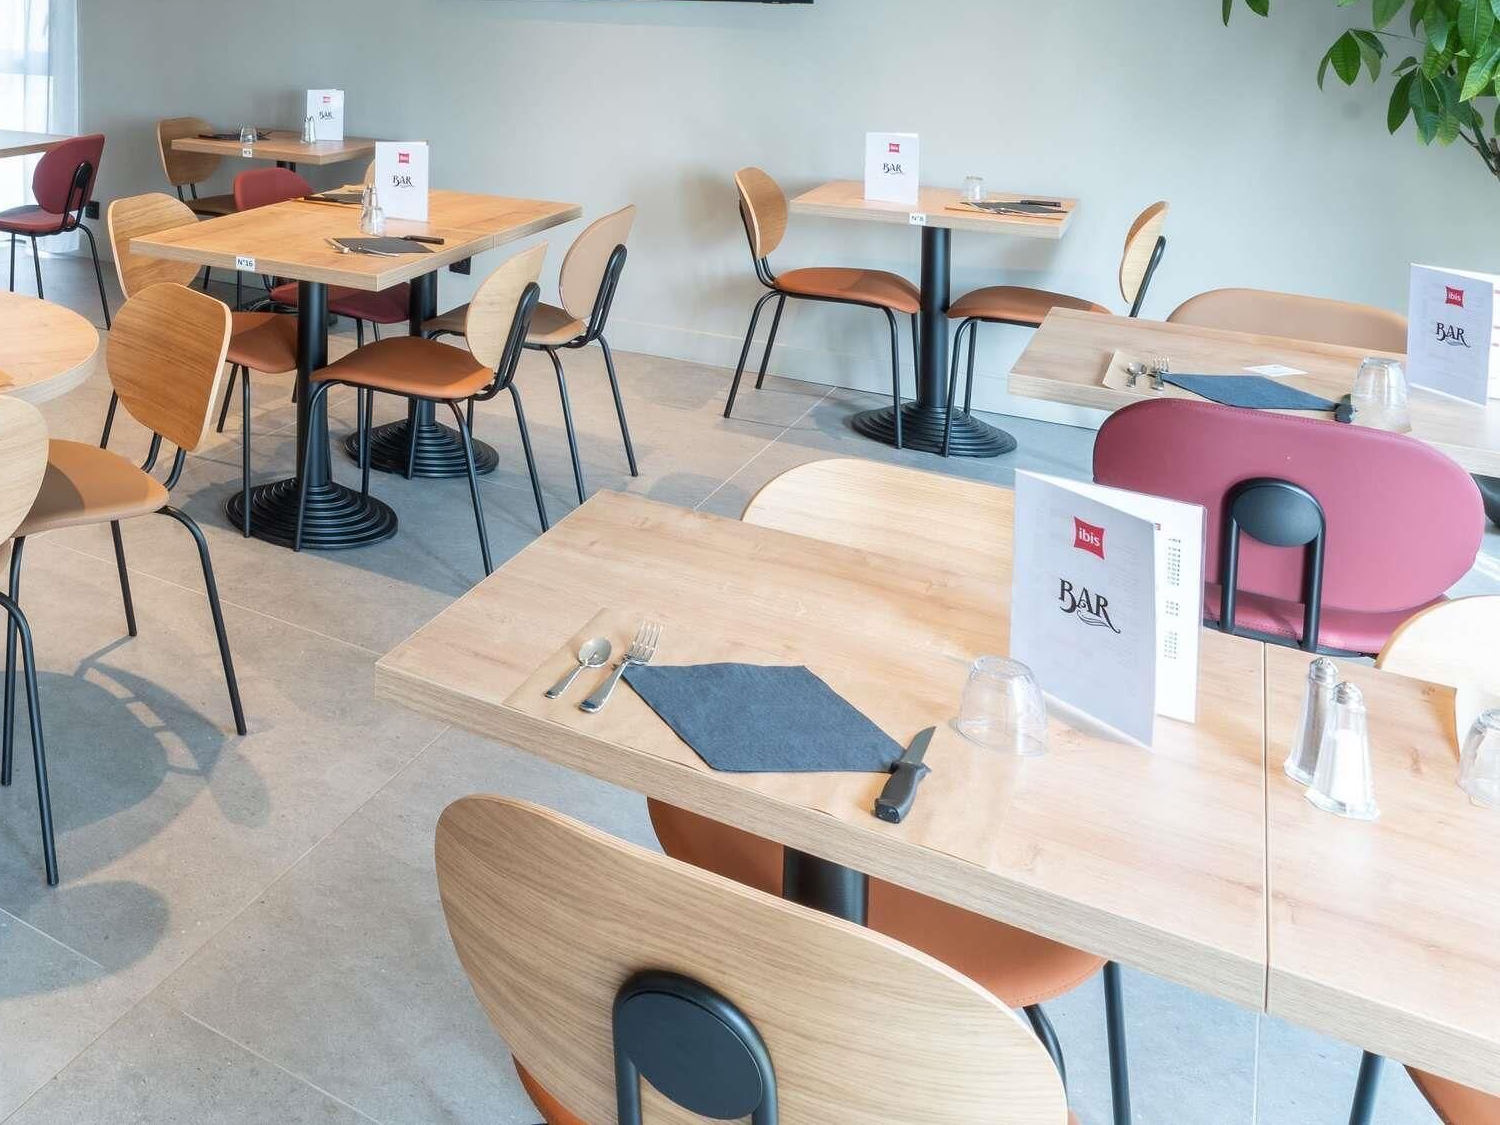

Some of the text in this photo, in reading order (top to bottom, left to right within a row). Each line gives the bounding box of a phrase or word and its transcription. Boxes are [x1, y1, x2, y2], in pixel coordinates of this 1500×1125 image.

[883, 163, 904, 175] BAR
[392, 174, 415, 188] BAR
[1448, 292, 1462, 302] ibis
[1435, 321, 1471, 348] BAR
[1079, 527, 1100, 547] ibis
[1058, 578, 1121, 634] BAR
